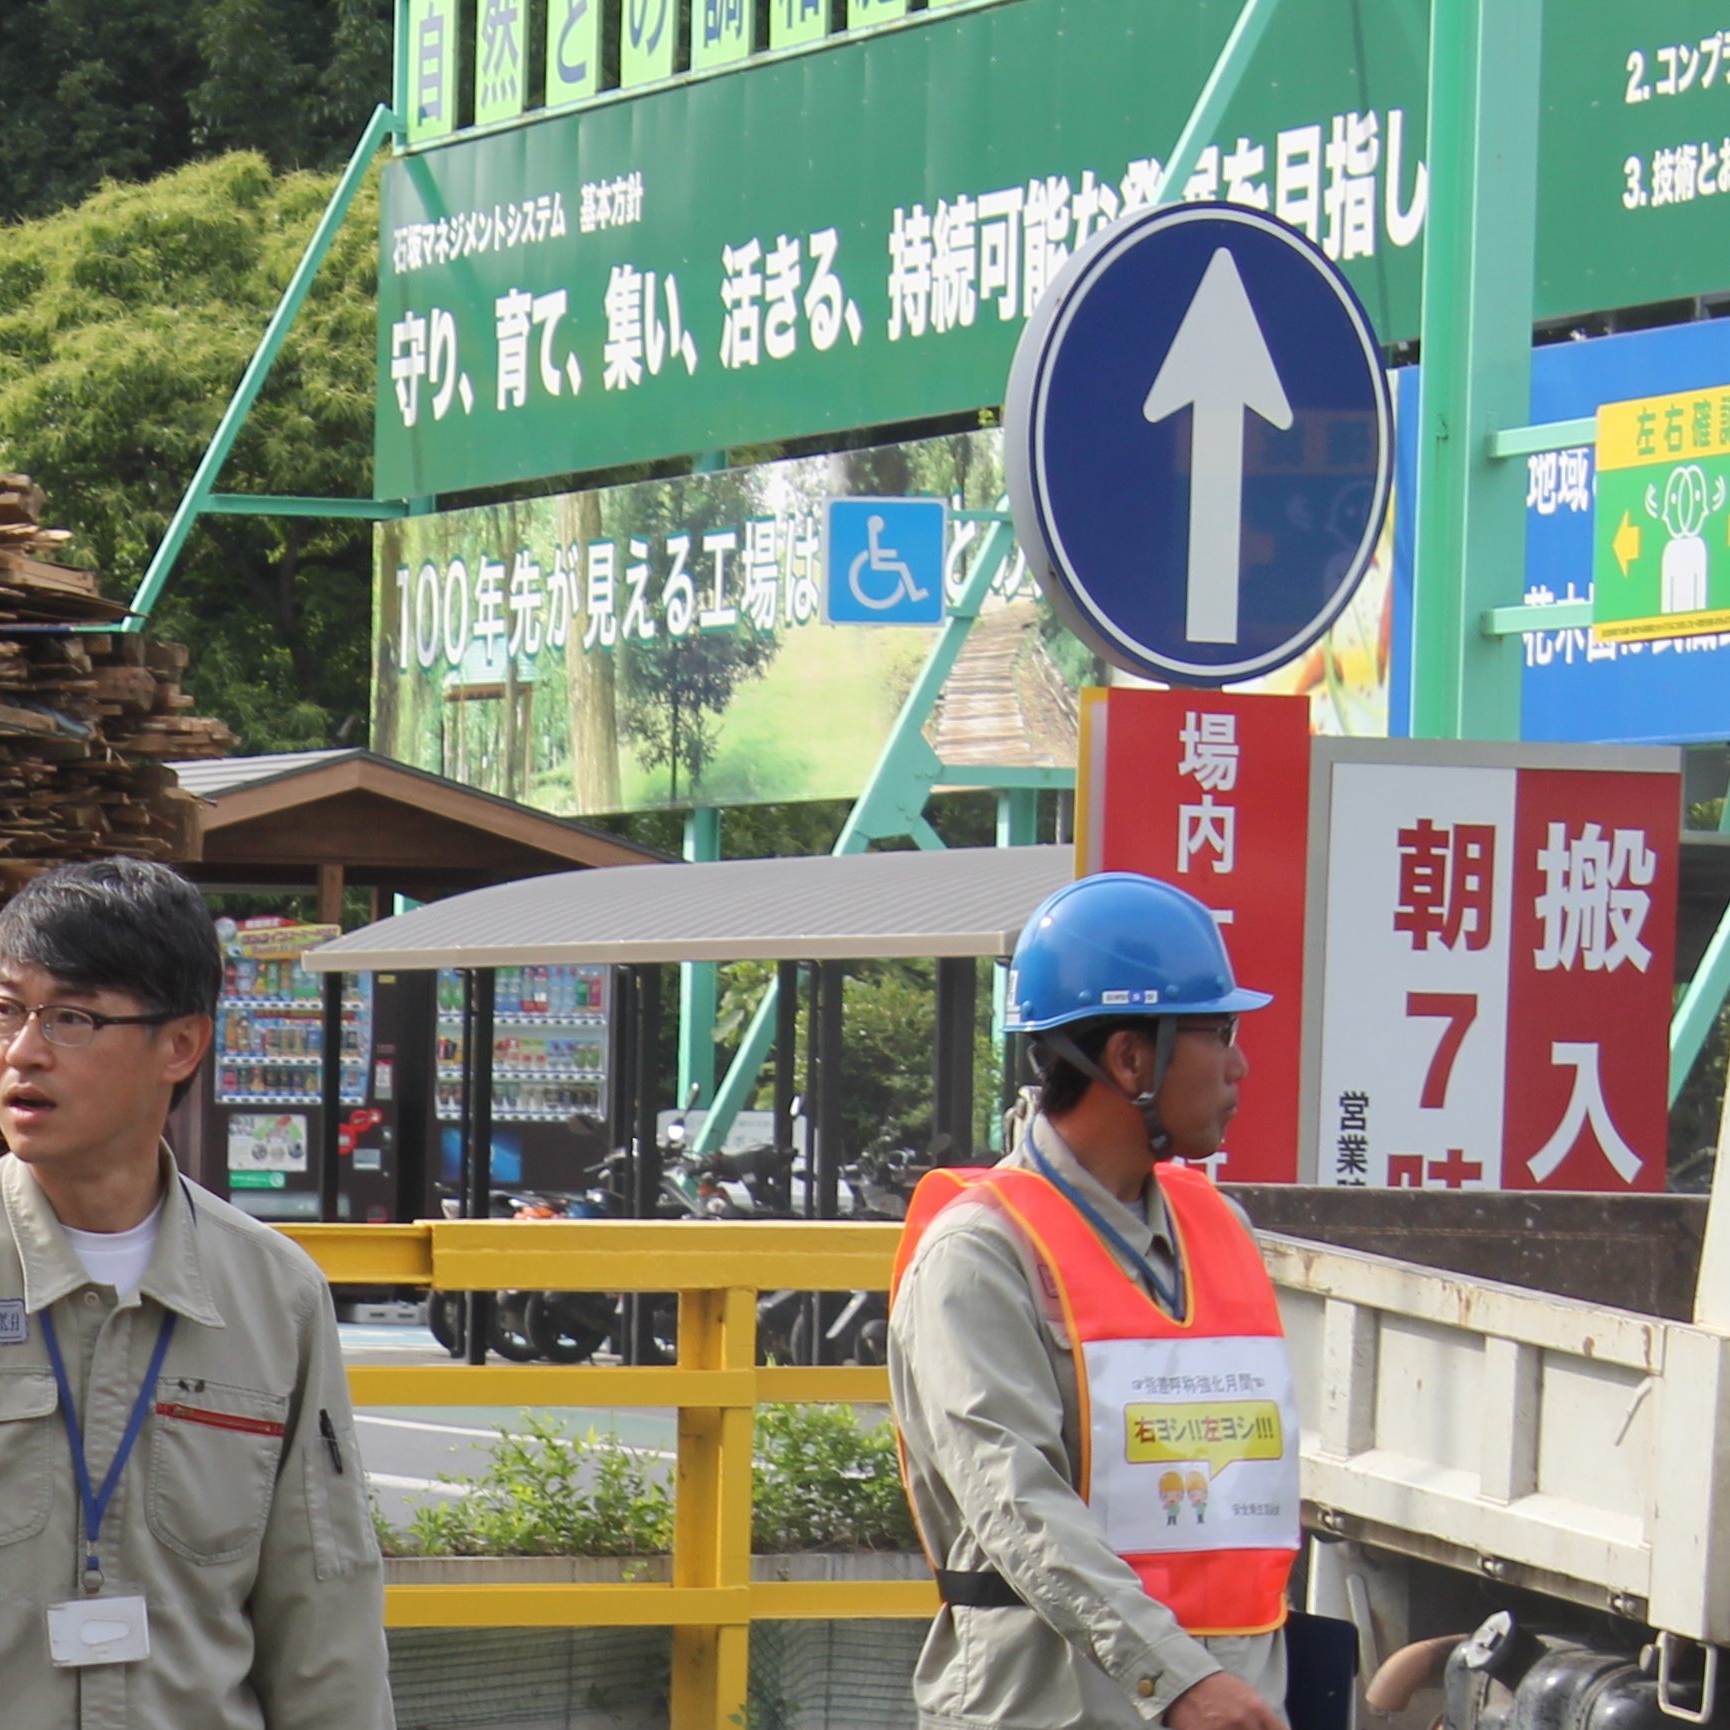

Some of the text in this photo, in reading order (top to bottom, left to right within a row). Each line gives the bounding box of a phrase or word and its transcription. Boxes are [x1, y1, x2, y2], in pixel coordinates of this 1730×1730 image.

[579, 172, 644, 233] 基本方針
[1527, 448, 1596, 515] 地域
[1526, 821, 1658, 1185] 搬入
[1337, 1090, 1369, 1187] 営業
